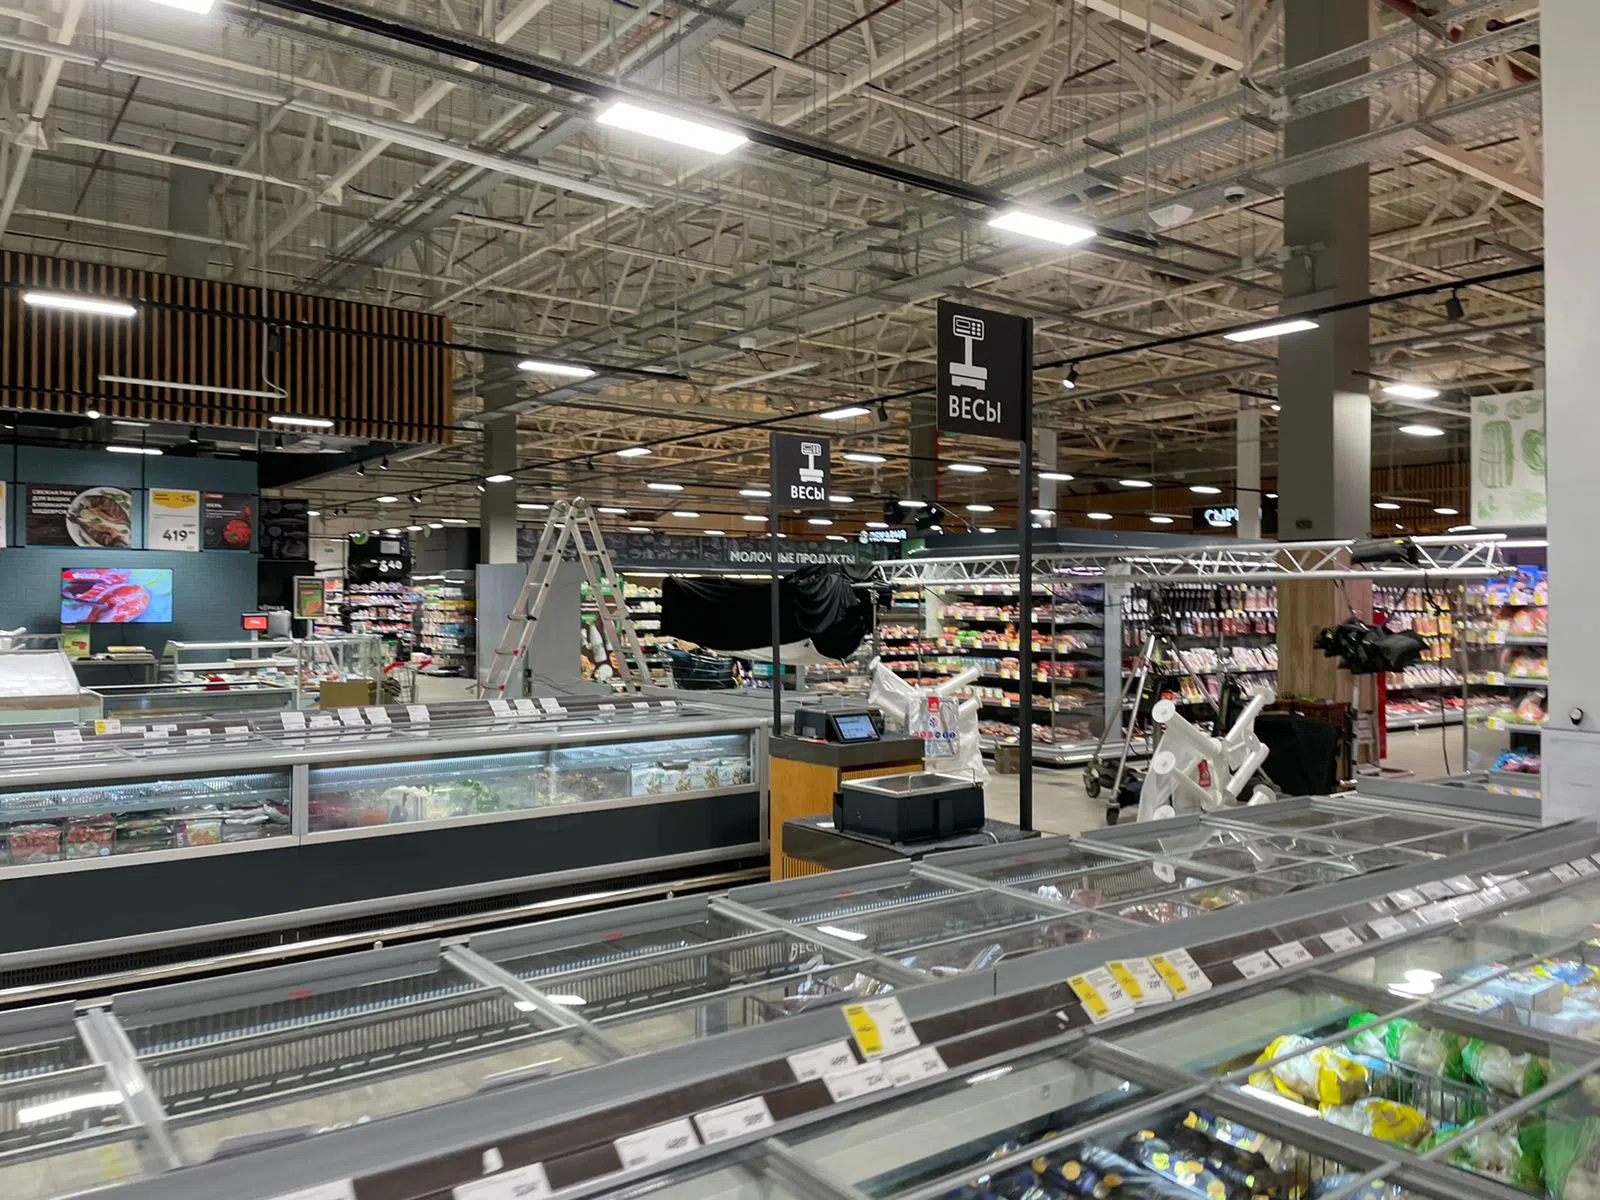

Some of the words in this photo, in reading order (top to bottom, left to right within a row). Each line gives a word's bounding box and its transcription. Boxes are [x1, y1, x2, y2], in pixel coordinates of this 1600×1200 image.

[949, 395, 1001, 423] ВЕСЫ
[790, 485, 825, 500] ВЕСЫ
[162, 530, 188, 542] 419
[796, 552, 856, 564] ПРОДУКТЫ
